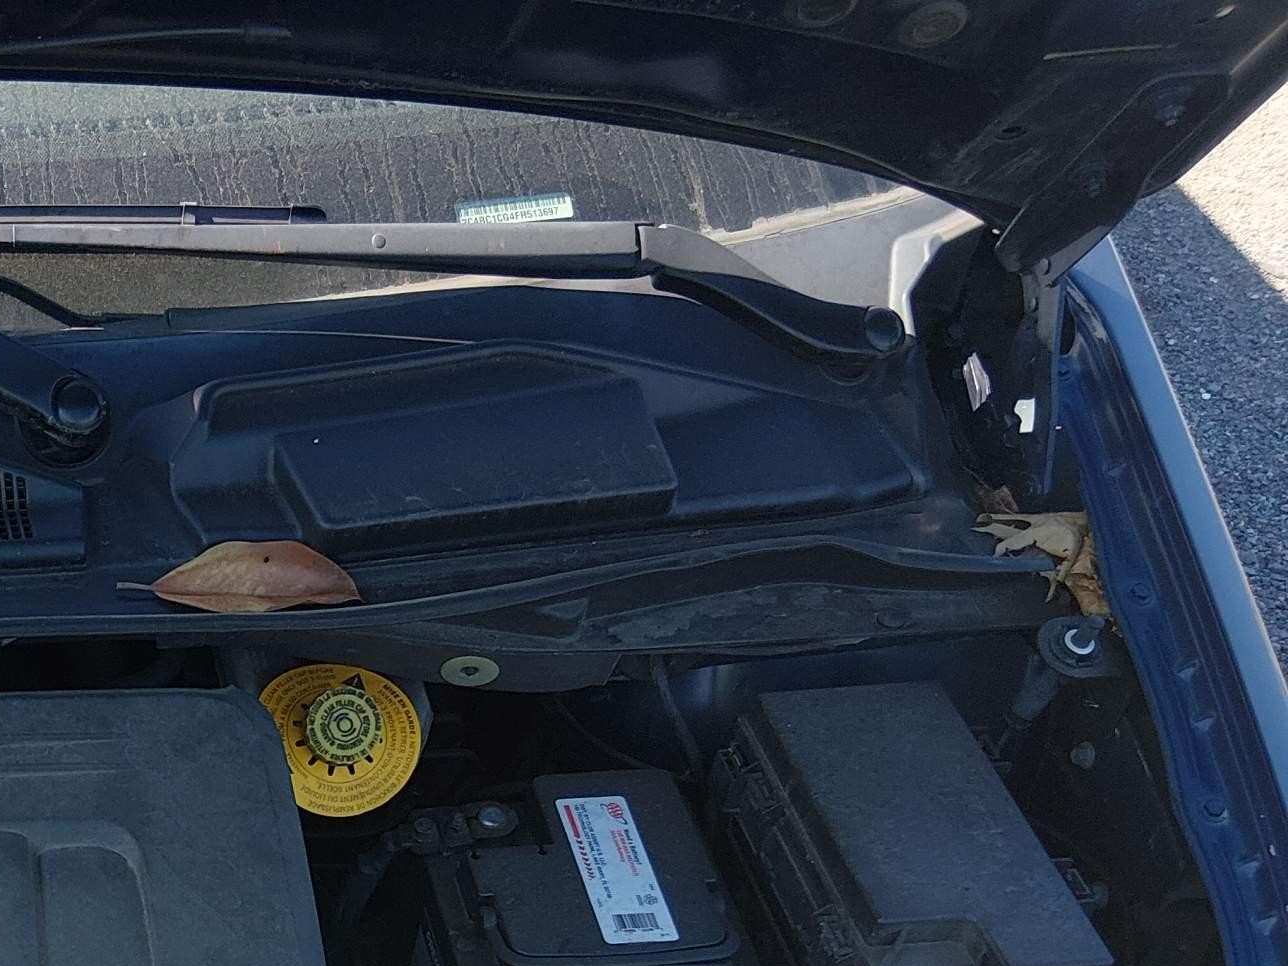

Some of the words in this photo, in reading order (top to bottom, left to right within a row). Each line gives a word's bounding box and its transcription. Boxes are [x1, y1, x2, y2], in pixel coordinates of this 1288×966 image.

[381, 682, 399, 699] MISE
[396, 697, 407, 709] EN
[402, 708, 415, 735] GARDE
